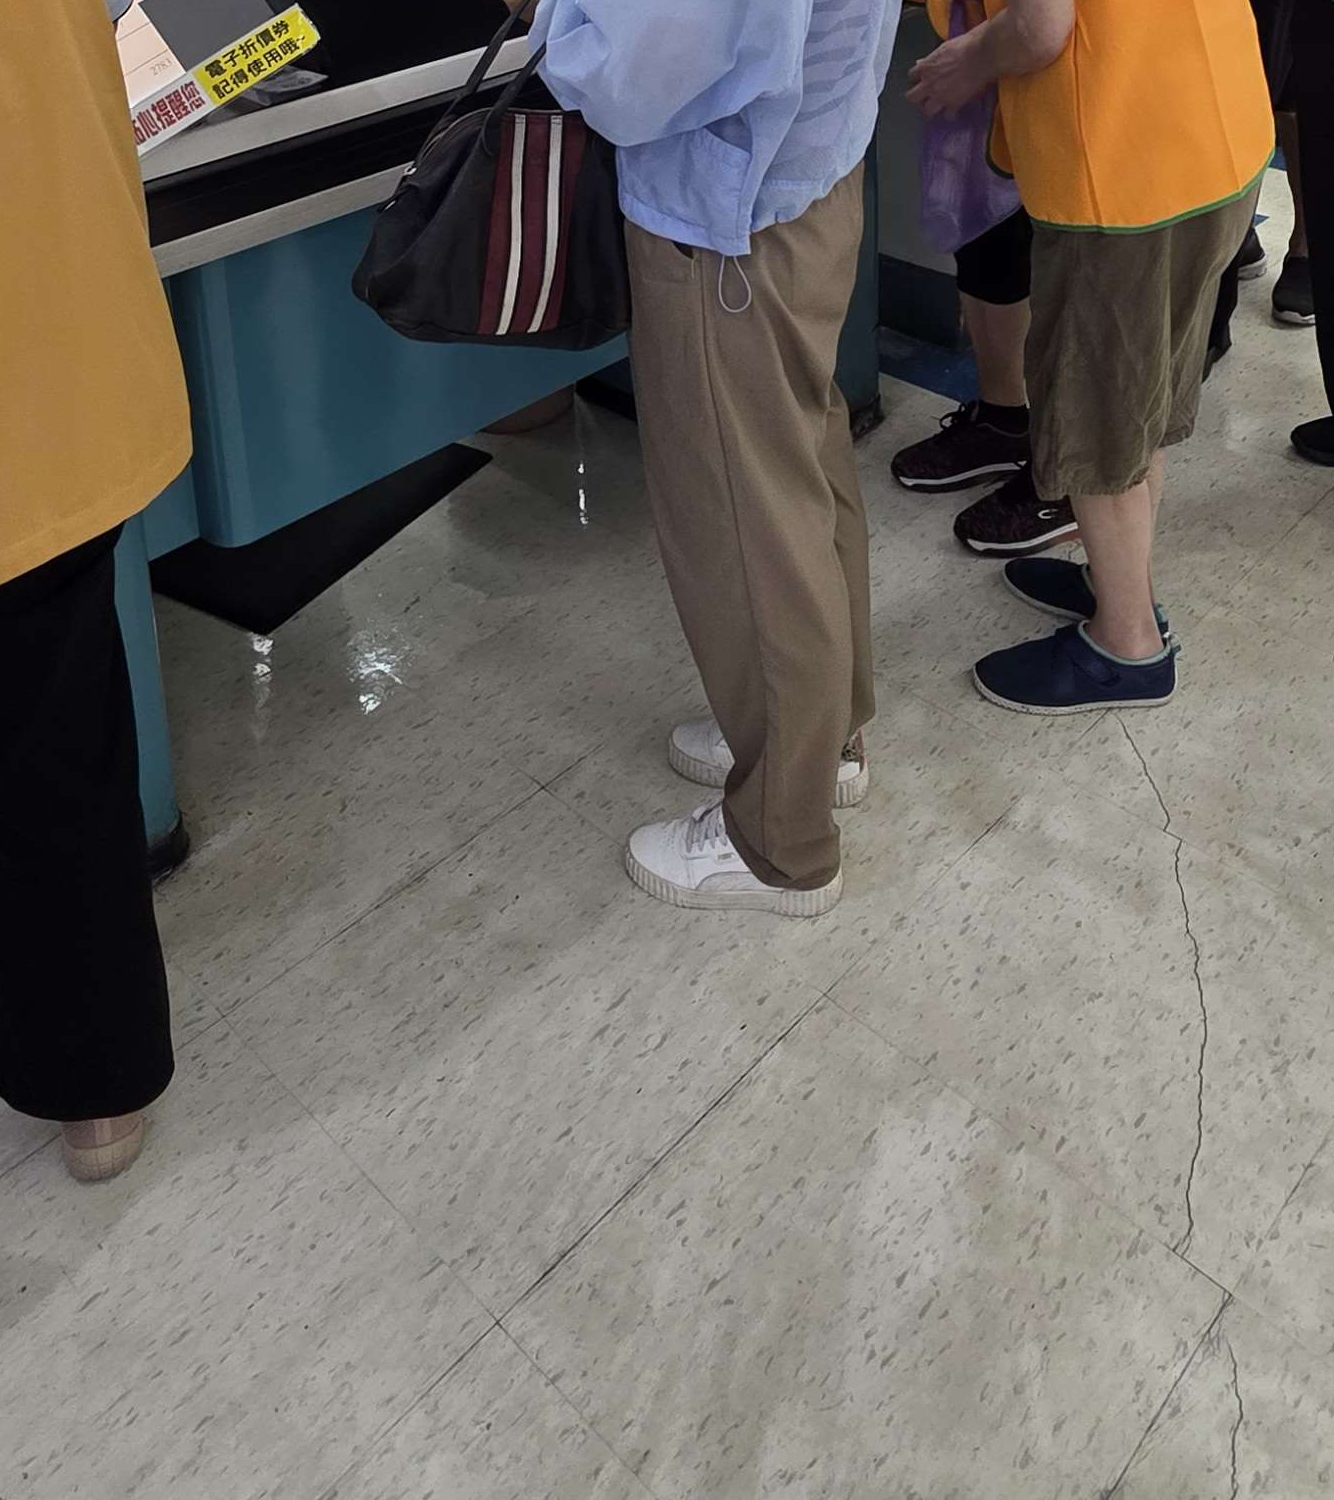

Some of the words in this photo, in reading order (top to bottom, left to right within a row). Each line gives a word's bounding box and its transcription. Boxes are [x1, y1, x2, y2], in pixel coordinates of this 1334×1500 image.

[205, 19, 290, 79] 電子折價券
